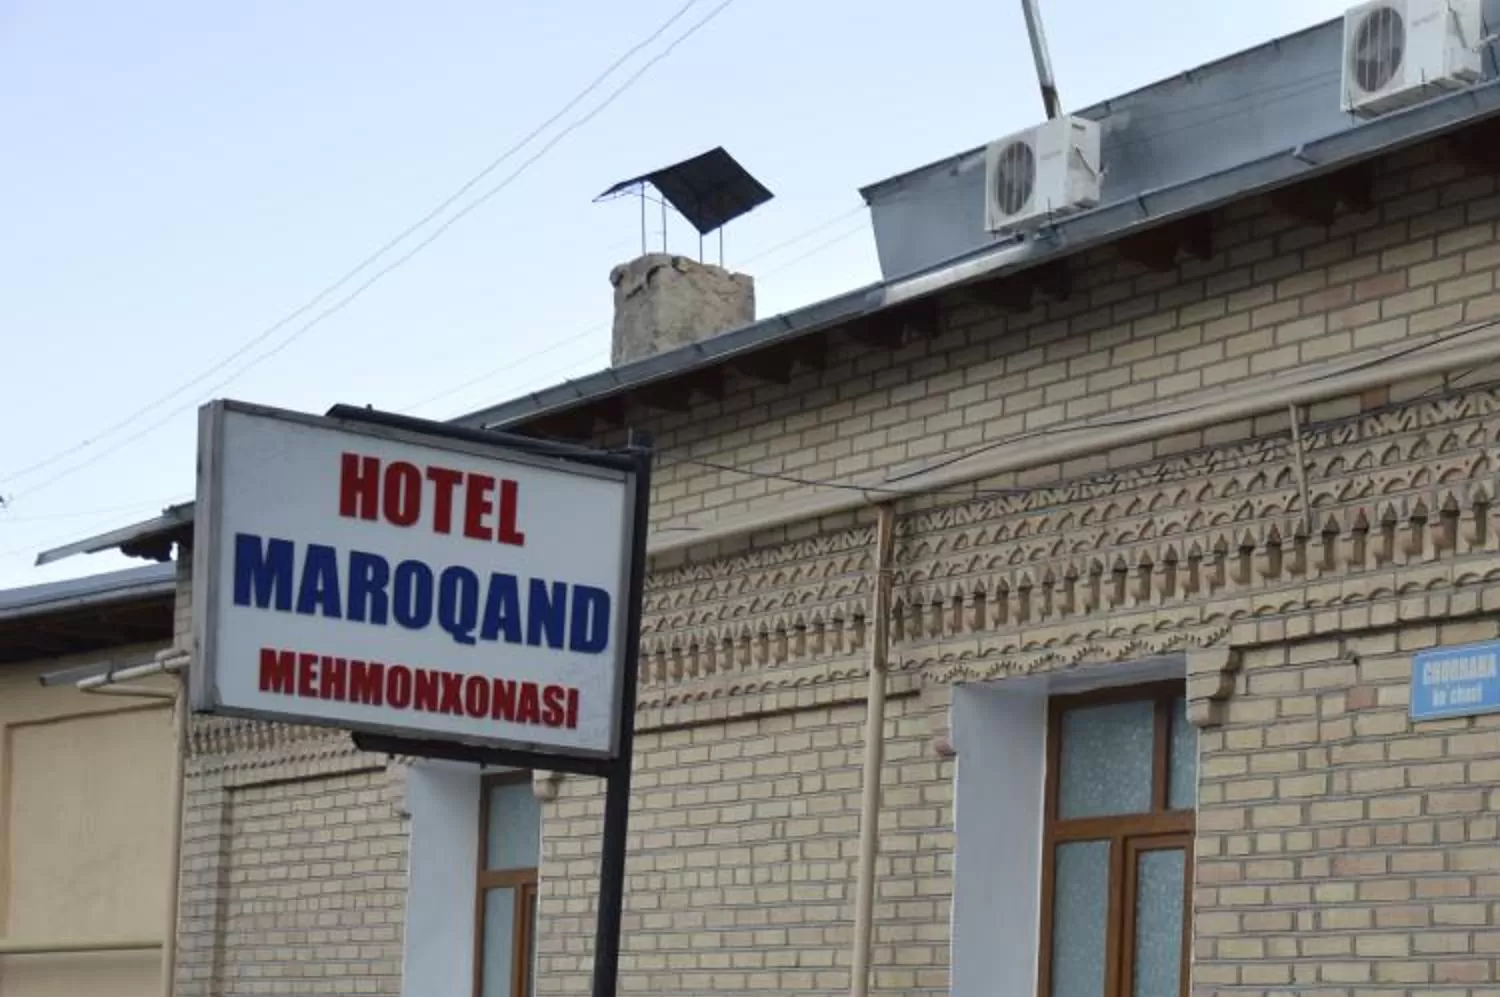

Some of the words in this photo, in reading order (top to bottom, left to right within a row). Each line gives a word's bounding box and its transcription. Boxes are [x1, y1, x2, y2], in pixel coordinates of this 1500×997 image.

[338, 451, 526, 547] HOTEL
[232, 532, 612, 655] MAROQAND
[258, 647, 580, 730] MEHMONXONASI
